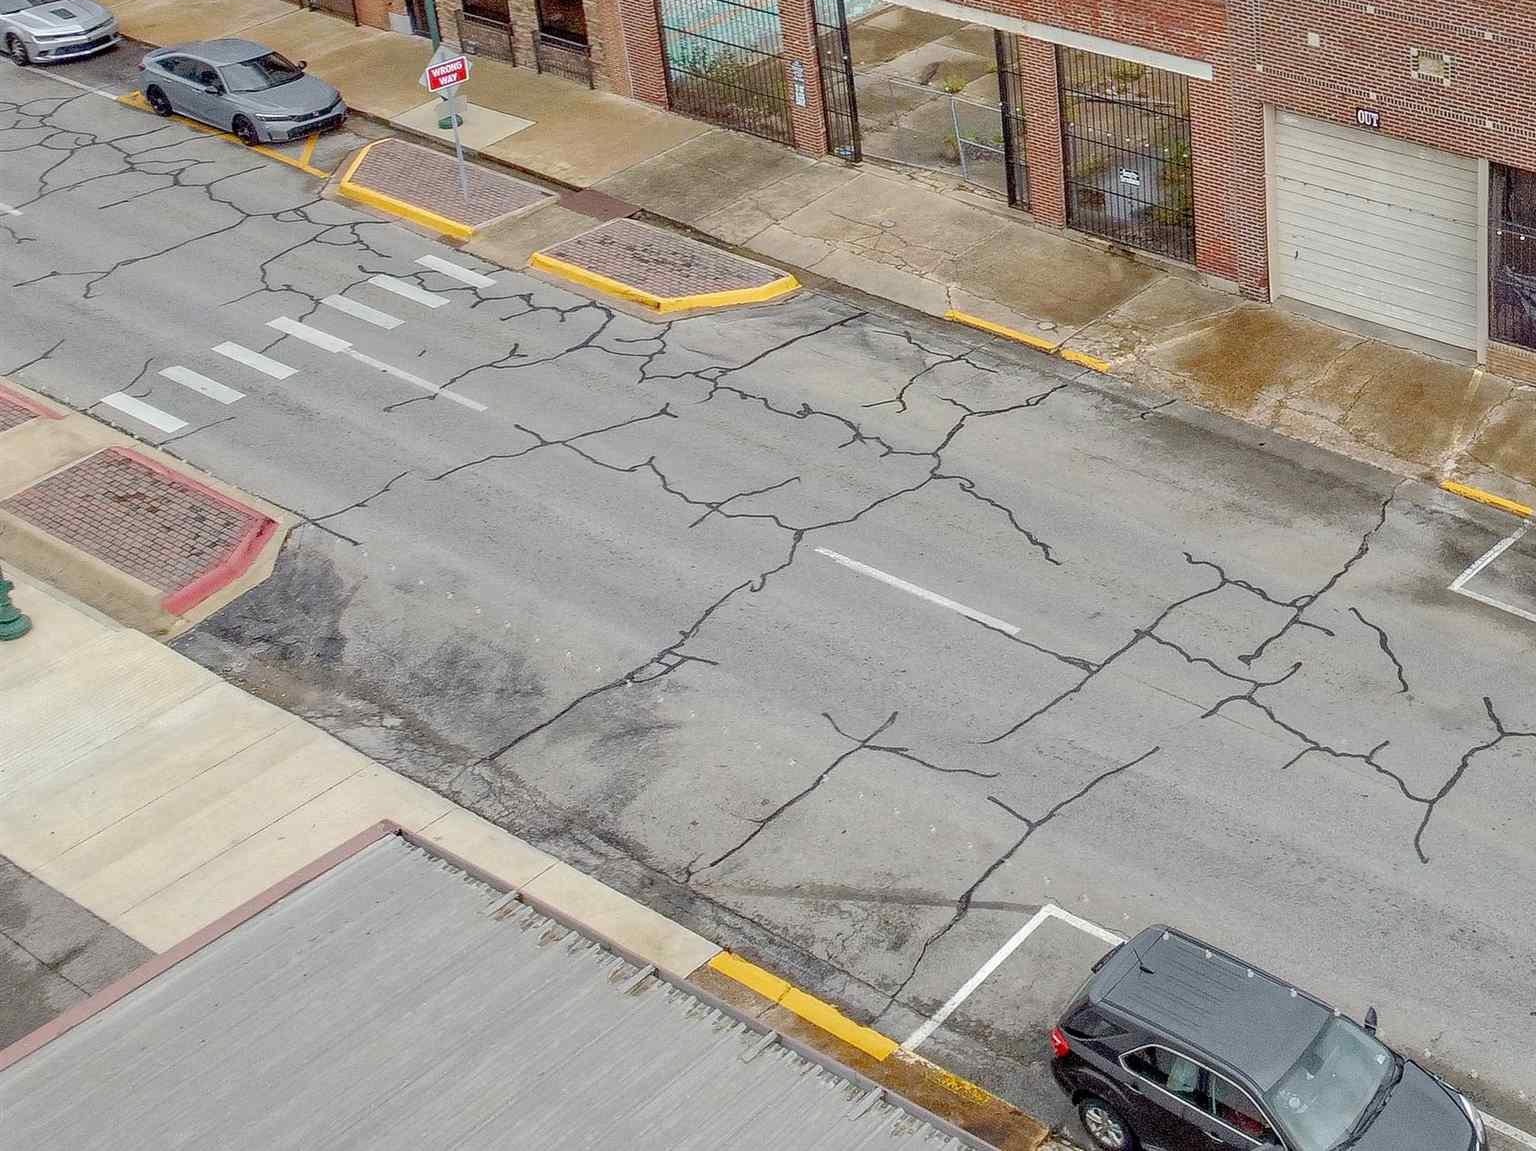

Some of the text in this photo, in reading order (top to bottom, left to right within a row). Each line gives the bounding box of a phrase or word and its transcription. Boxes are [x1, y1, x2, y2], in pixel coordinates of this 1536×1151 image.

[431, 61, 463, 77] WRONG
[438, 72, 459, 86] WAY
[1357, 109, 1379, 127] OUT
